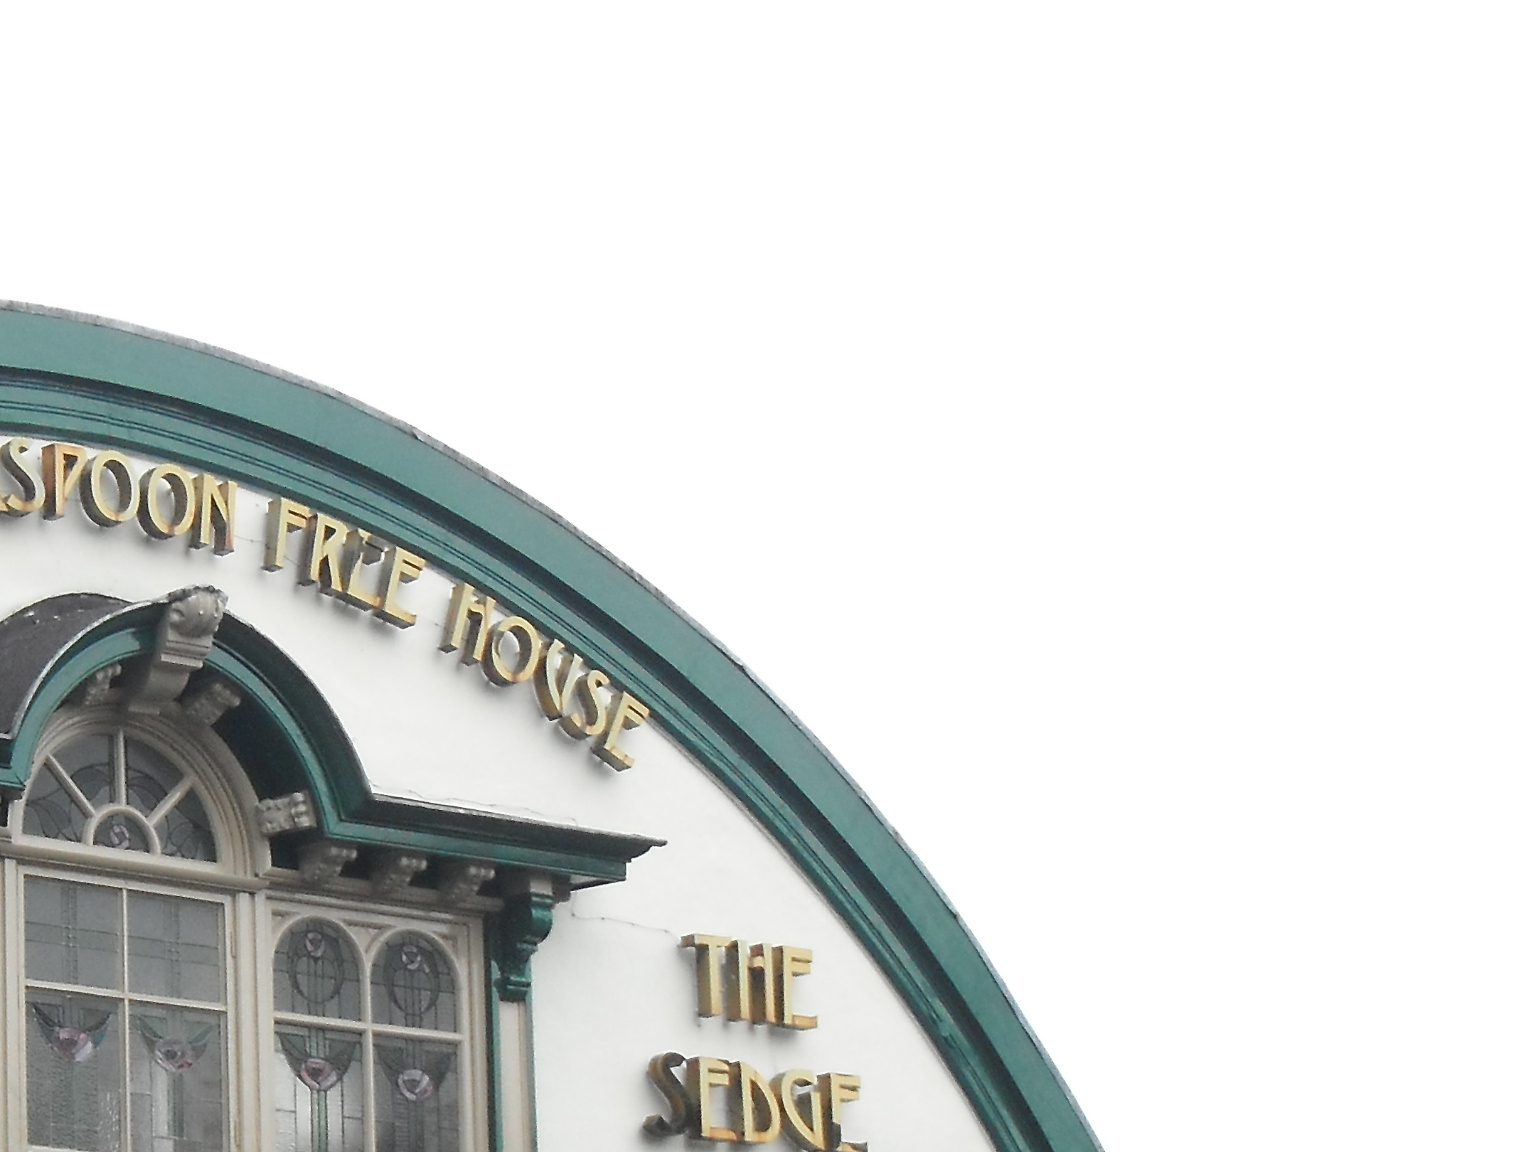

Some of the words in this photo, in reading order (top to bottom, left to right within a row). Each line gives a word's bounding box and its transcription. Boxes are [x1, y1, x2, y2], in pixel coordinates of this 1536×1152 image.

[261, 496, 426, 629] FREE
[439, 582, 650, 772] HOUSE
[679, 933, 818, 1031] THE
